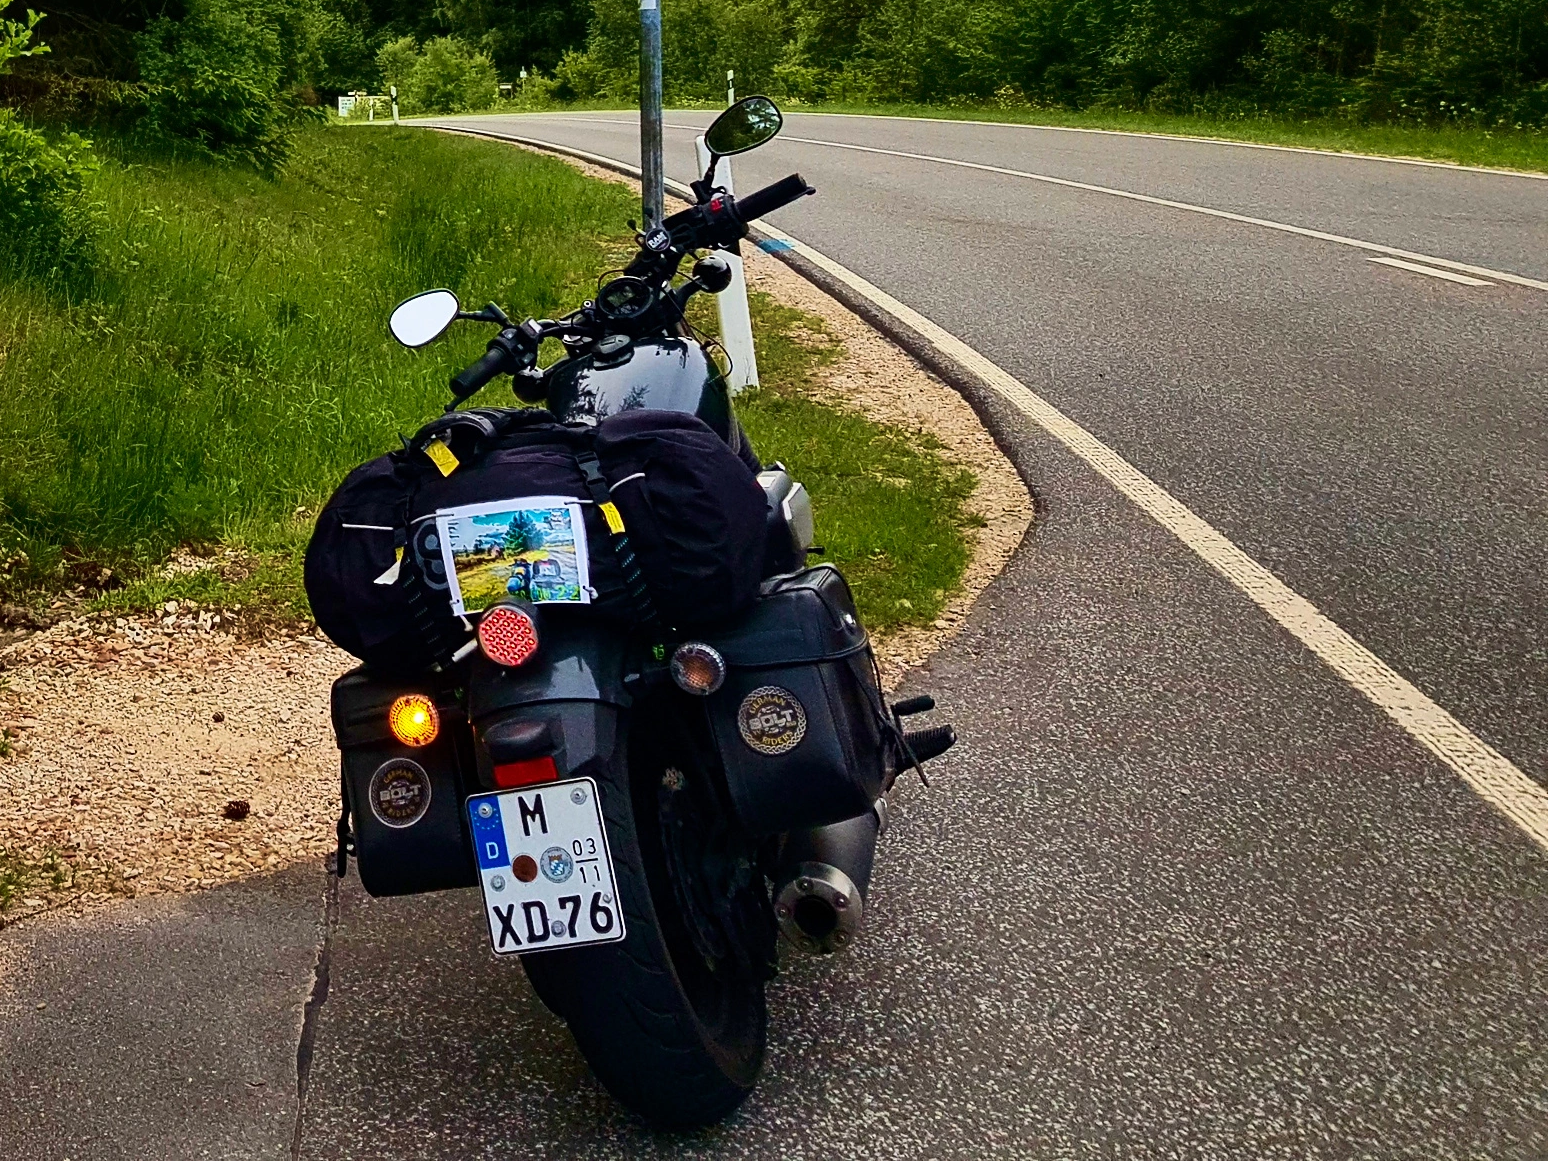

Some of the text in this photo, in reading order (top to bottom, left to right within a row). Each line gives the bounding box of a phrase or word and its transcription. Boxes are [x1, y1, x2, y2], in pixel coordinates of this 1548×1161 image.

[517, 793, 549, 837] M
[485, 841, 500, 860] D
[572, 837, 597, 857] 03
[579, 864, 602, 884] 11
